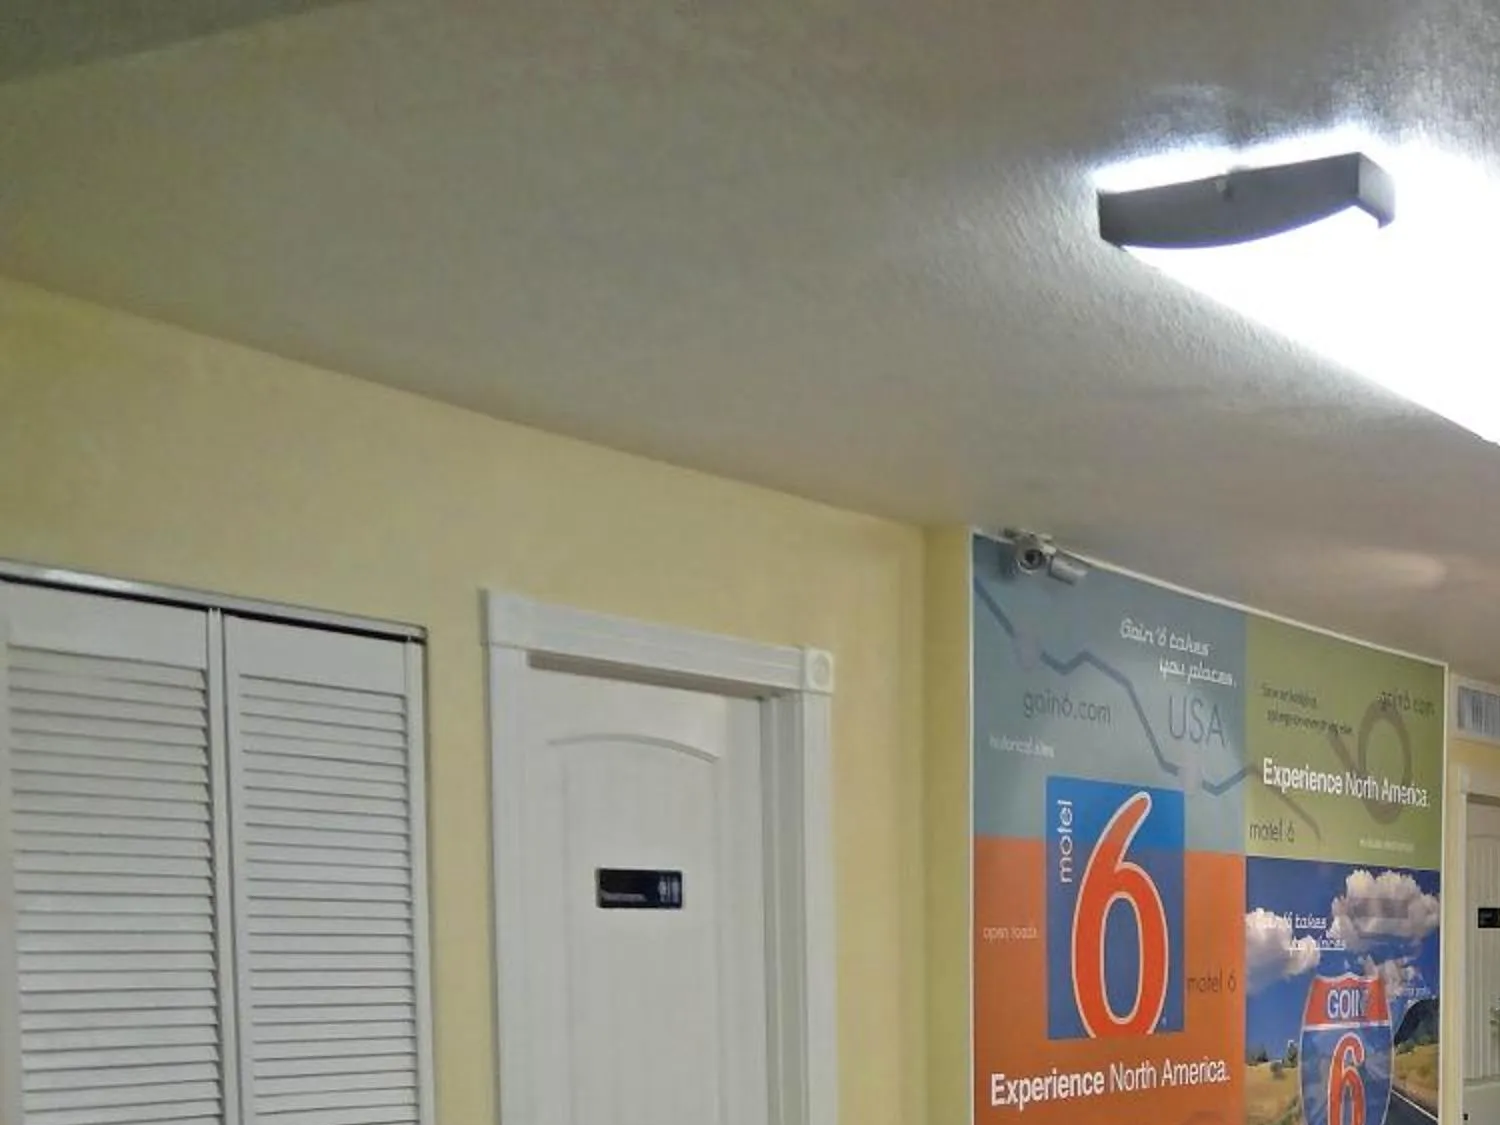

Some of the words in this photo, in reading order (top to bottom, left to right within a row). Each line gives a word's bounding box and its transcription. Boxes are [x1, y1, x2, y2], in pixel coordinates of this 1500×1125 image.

[1169, 632, 1211, 656] takes
[1160, 656, 1185, 680] you
[1023, 688, 1111, 723] goin6.com
[1168, 695, 1226, 747] USA
[1262, 756, 1343, 795] Experience
[1345, 771, 1379, 800] North
[1057, 799, 1073, 883] motel
[1250, 820, 1283, 841] motel
[1071, 791, 1169, 1038] 6
[1187, 970, 1223, 993] motel
[991, 1067, 1105, 1111] Experience
[1109, 1062, 1157, 1093] North
